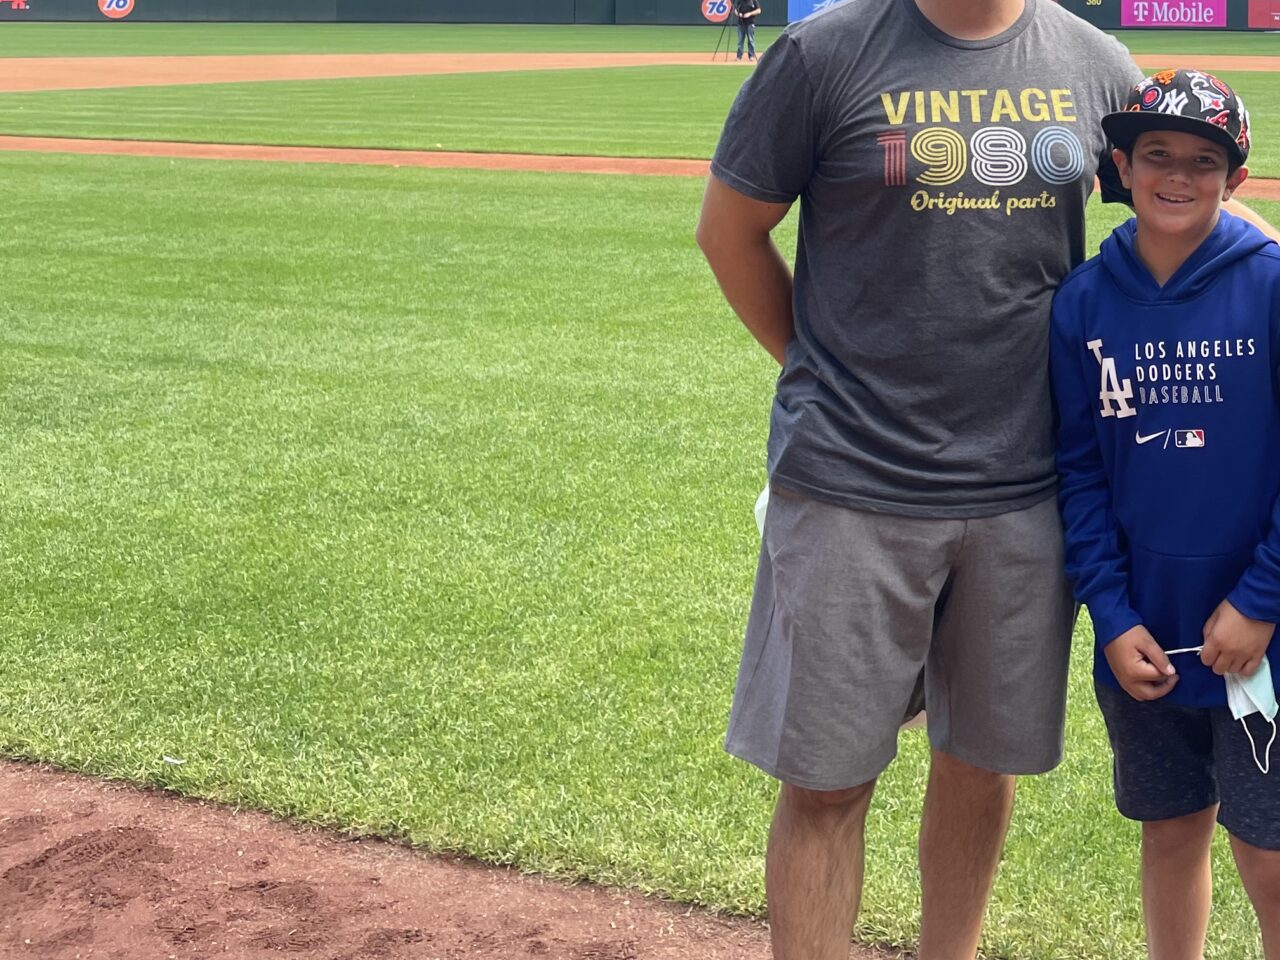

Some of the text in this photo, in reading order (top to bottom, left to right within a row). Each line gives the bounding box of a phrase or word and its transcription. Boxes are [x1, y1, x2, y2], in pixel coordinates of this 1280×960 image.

[708, 0, 728, 14] 76
[1151, 2, 1214, 23] Mobile
[881, 87, 1076, 125] VINTAGE
[1158, 89, 1188, 116] NY
[876, 125, 1085, 187] 1980
[911, 190, 1056, 216] Original parts
[1135, 338, 1256, 360] LOS ANGELES
[1087, 339, 1137, 419] LA
[1136, 363, 1217, 382] DODGERS
